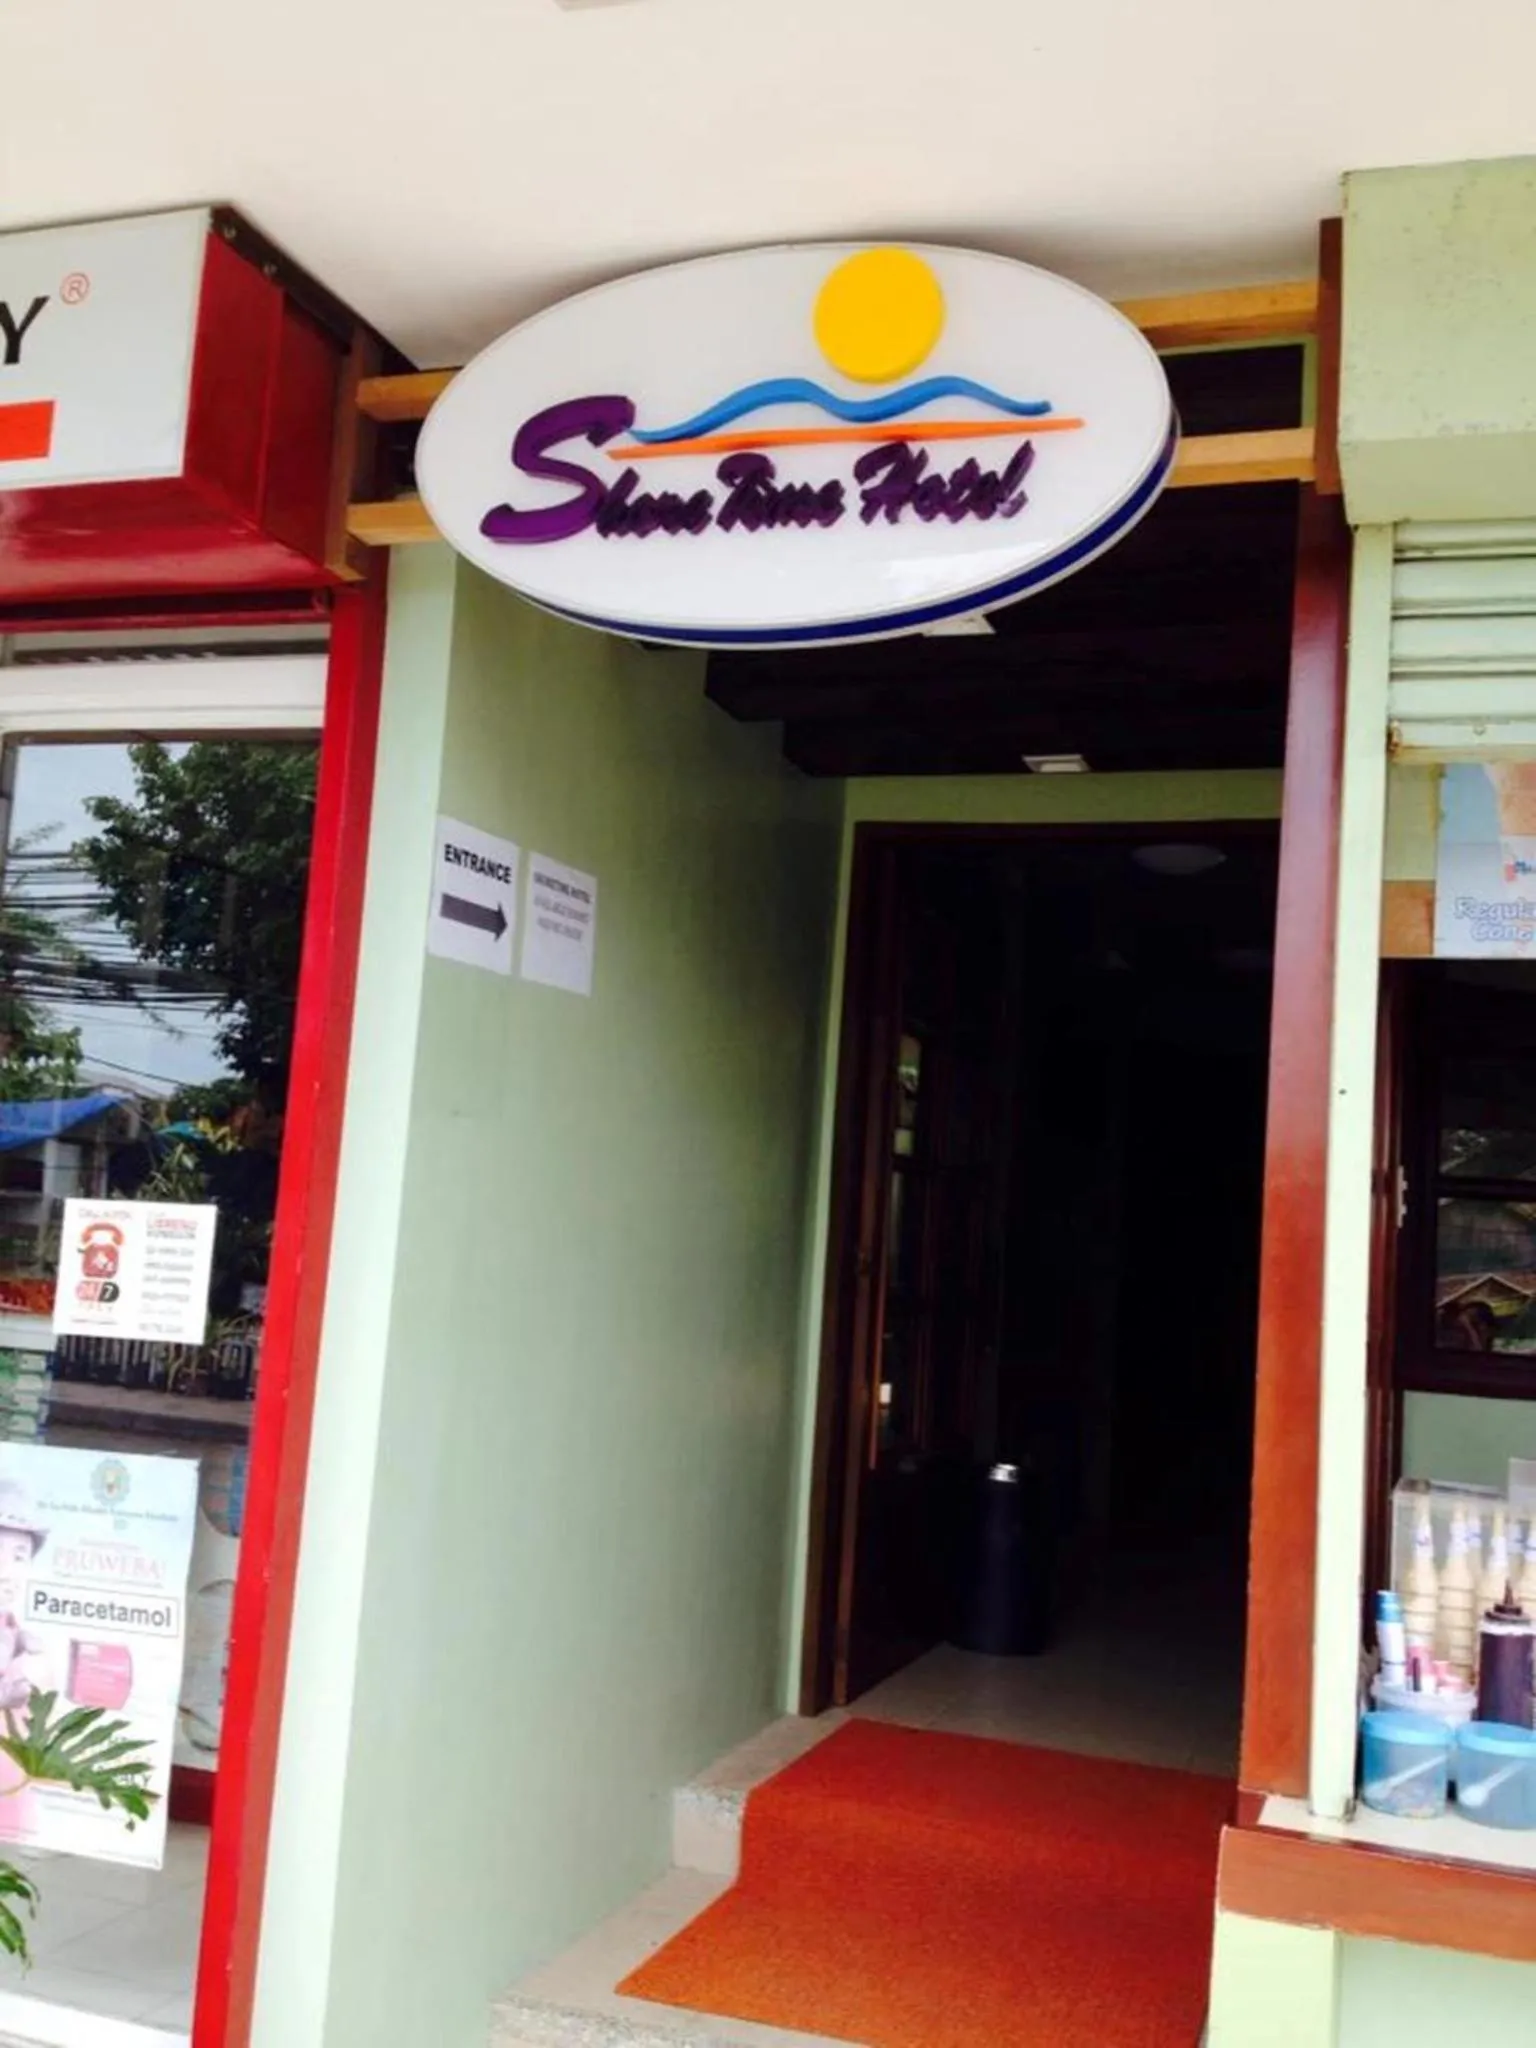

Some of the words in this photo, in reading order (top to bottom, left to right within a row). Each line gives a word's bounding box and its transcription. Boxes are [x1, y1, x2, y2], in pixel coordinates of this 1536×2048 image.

[480, 395, 714, 544] Shore
[715, 452, 845, 533] Time
[854, 440, 1034, 525] Hotel
[444, 843, 511, 884] ENTRANCE
[33, 1591, 172, 1627] Paracetamol
